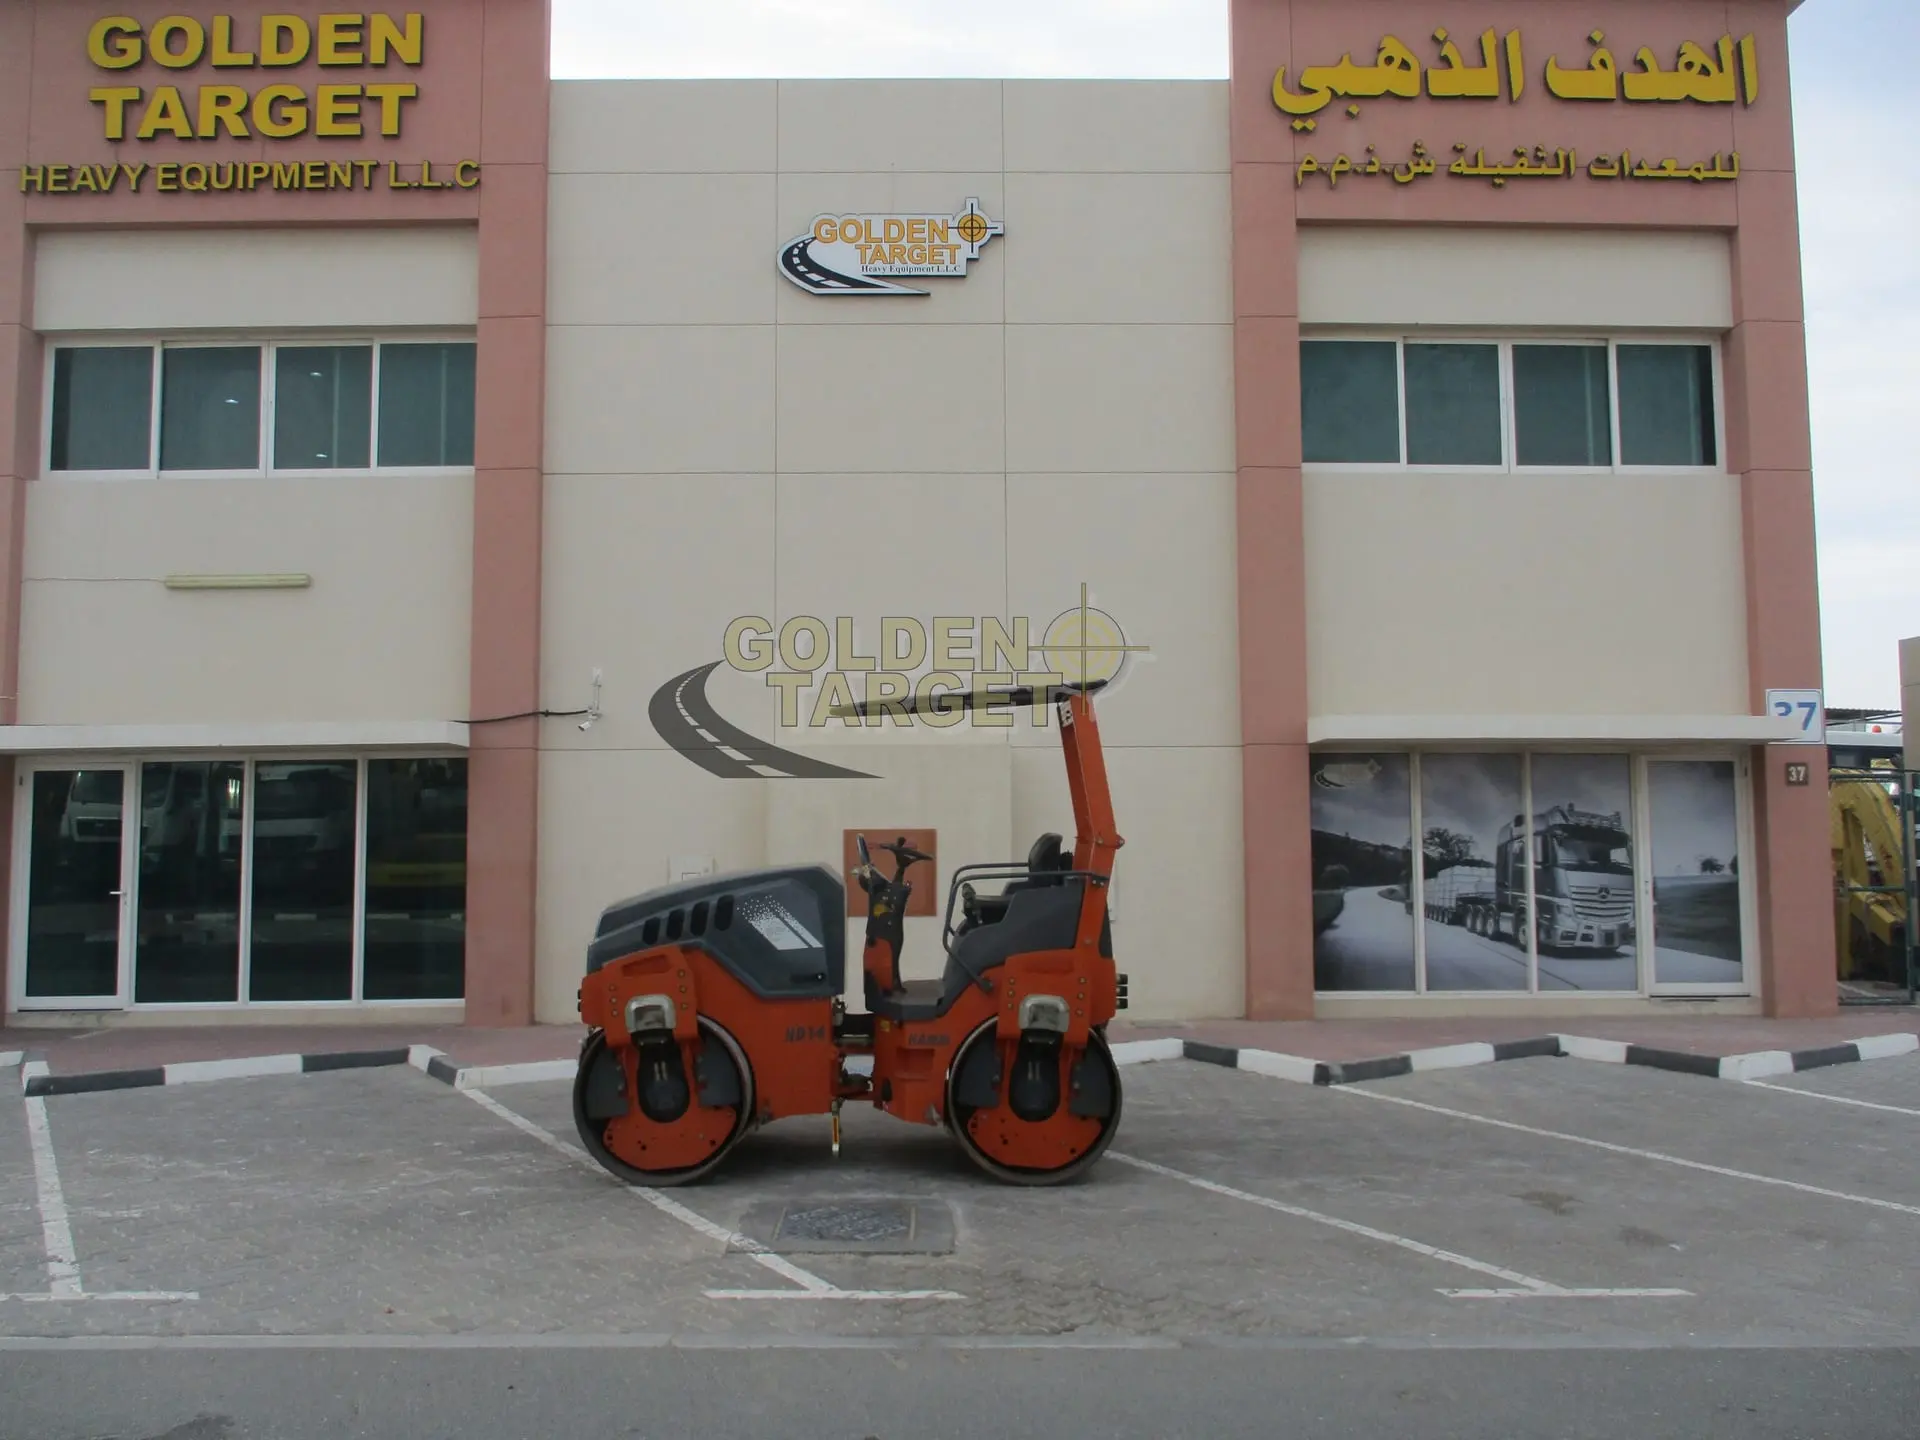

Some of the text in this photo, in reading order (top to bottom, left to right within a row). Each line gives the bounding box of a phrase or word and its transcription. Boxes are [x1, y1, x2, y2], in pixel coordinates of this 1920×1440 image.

[87, 14, 425, 69] GOLDEN
[1272, 27, 1759, 132] الهدف الذهبي
[89, 84, 418, 140] TARGET
[20, 160, 481, 193] HEAVY EQUIPMENT L.L.C
[1449, 143, 1577, 188] الثقيلة
[1588, 148, 1740, 181] للمعدات
[814, 218, 949, 244] GOLDEN
[855, 243, 961, 265] TARGET
[861, 264, 887, 275] Heavy
[889, 264, 935, 275] Equipment
[1788, 766, 1806, 782] 37
